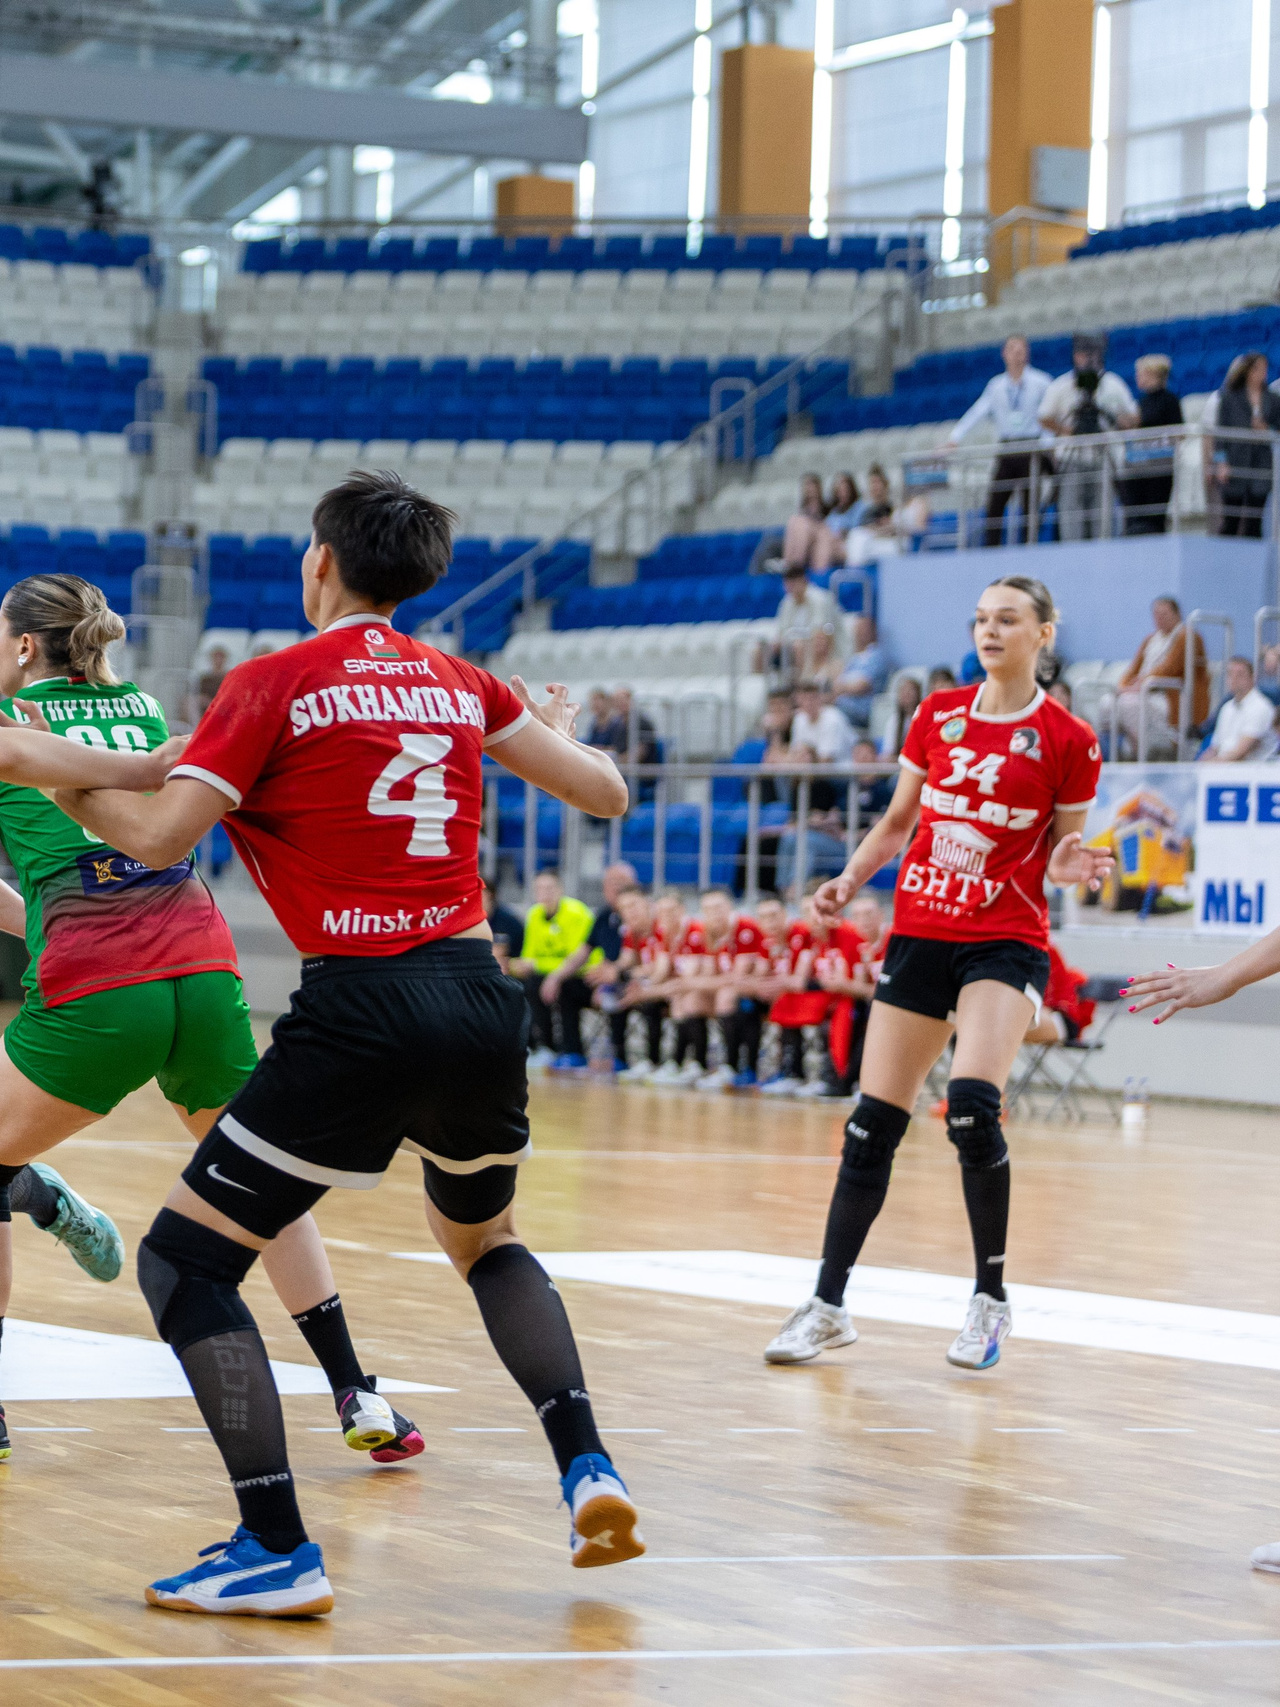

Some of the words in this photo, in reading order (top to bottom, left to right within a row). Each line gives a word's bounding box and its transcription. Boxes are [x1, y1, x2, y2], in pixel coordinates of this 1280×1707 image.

[343, 658, 438, 680] SPORTIX
[939, 747, 1007, 796] 34
[368, 734, 458, 857] 4
[921, 783, 1039, 830] BELAZ
[901, 863, 1005, 908] БНТУ
[1203, 880, 1264, 924] МЫ
[322, 908, 414, 935] Minsk
